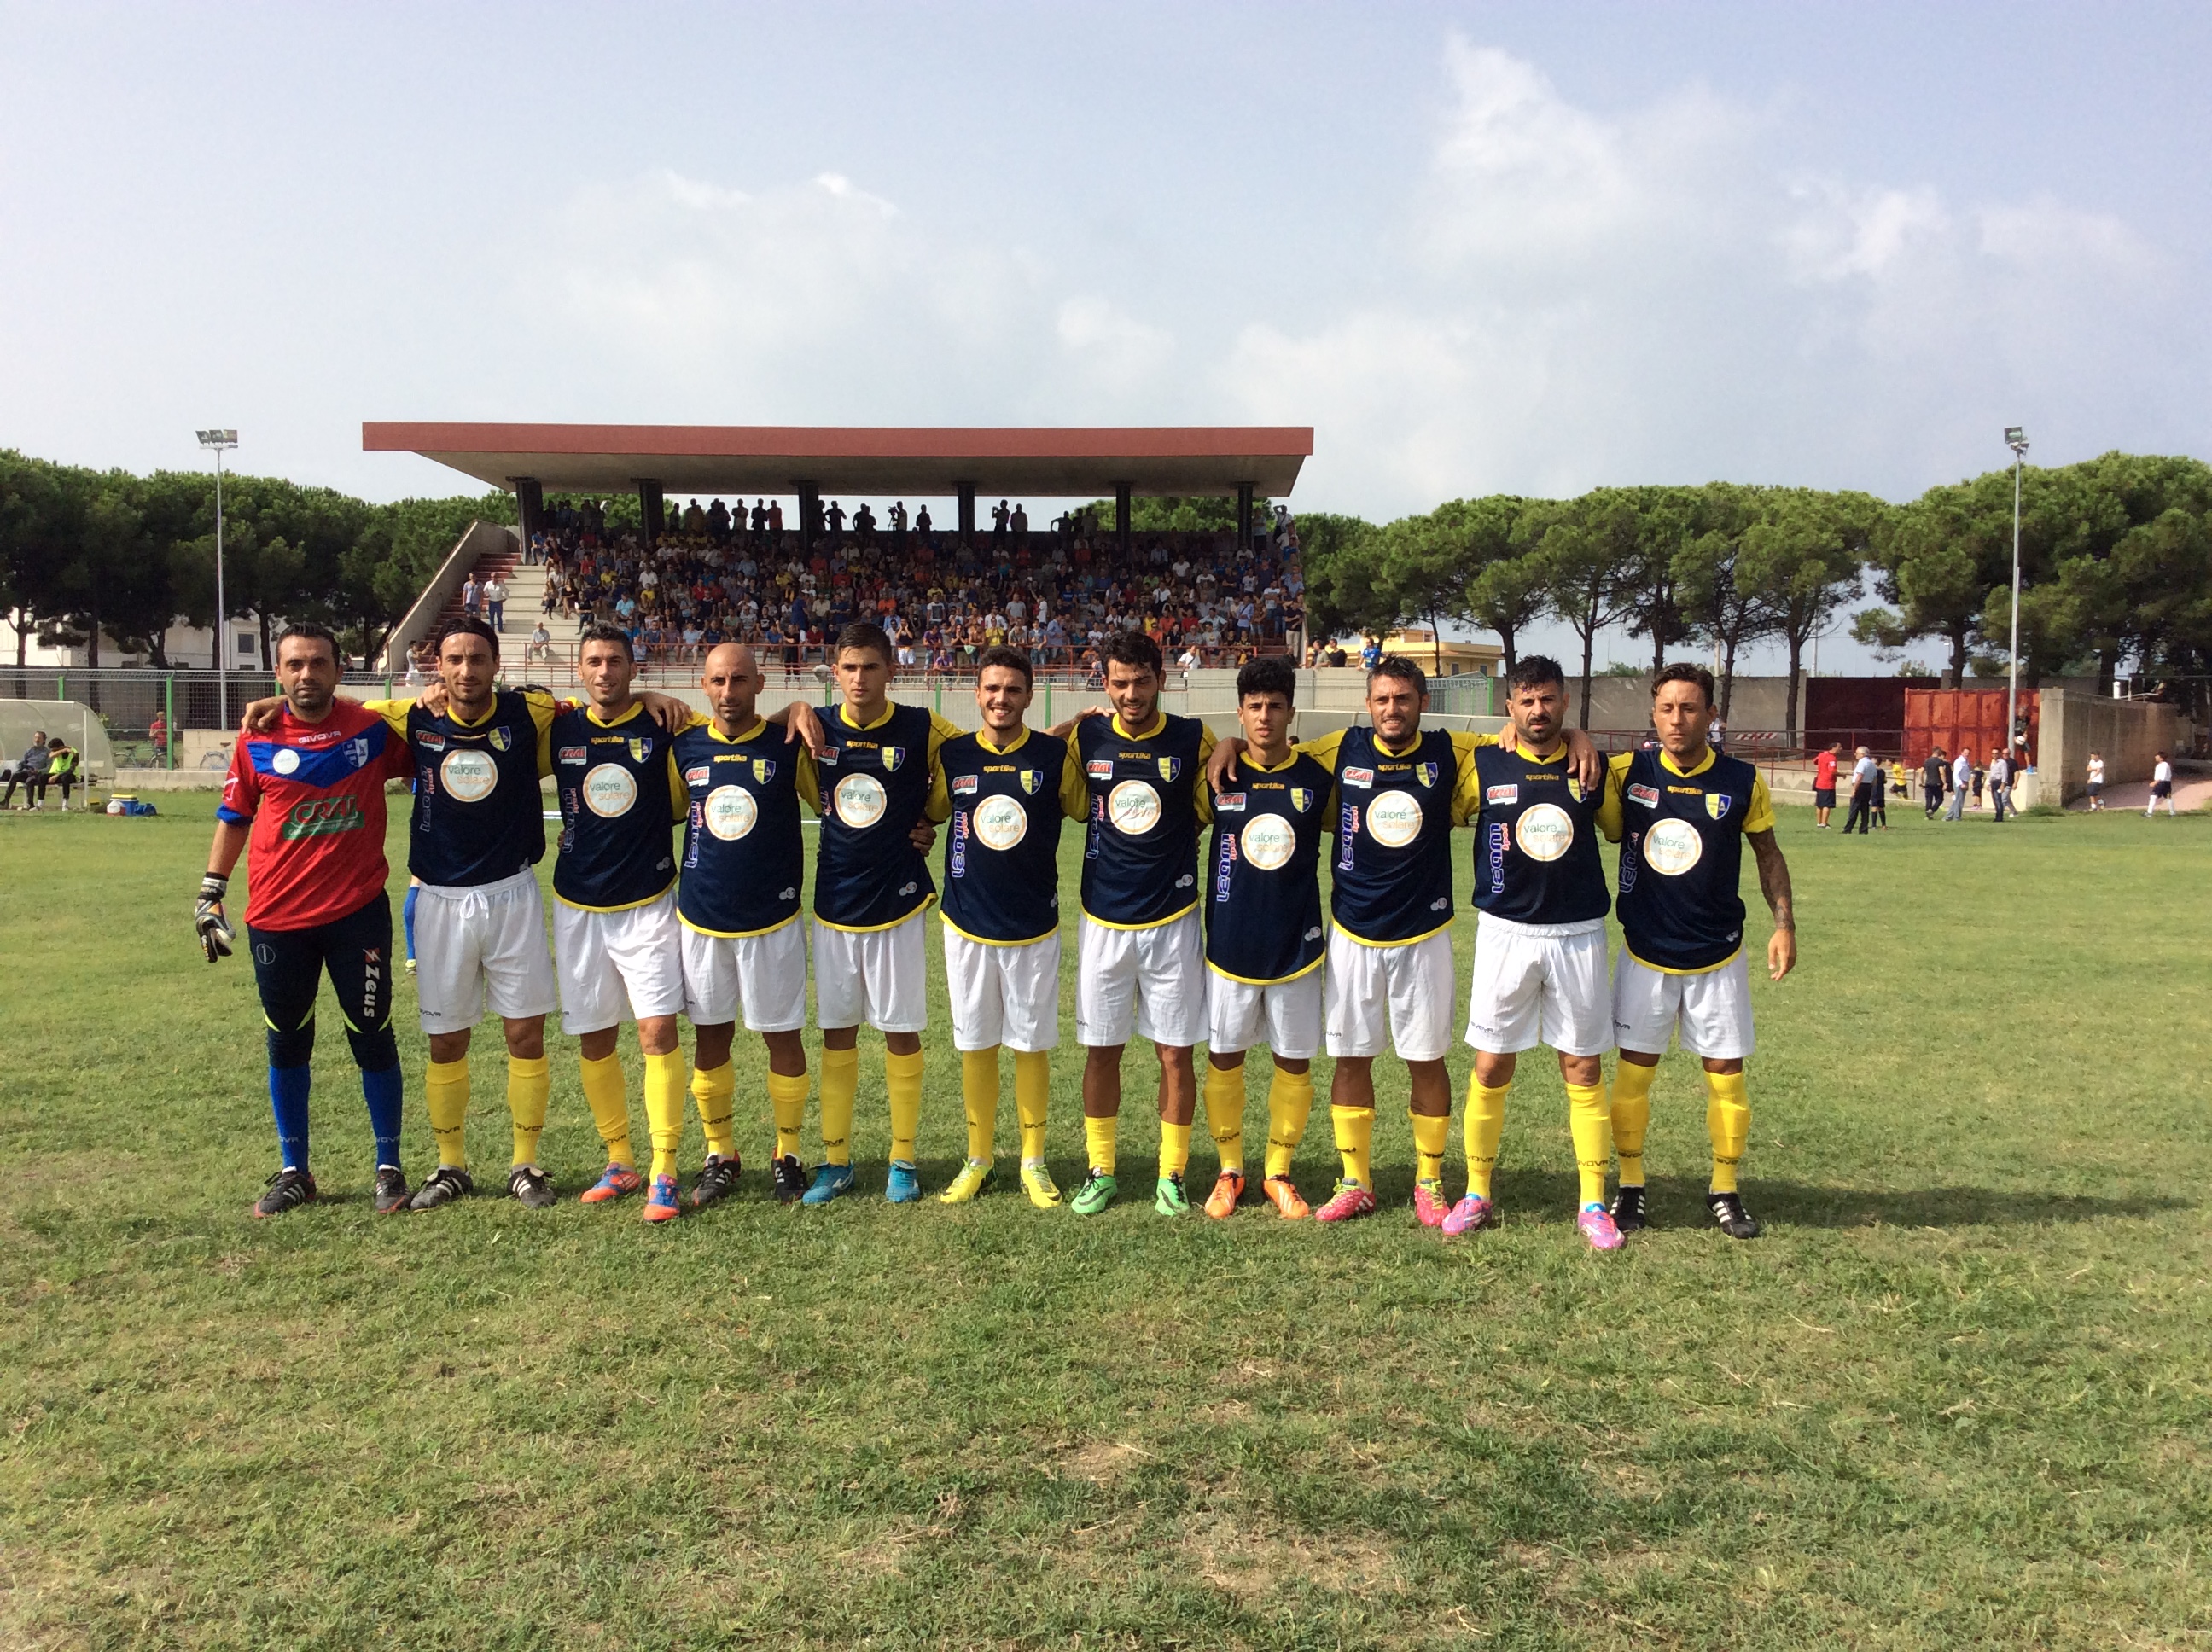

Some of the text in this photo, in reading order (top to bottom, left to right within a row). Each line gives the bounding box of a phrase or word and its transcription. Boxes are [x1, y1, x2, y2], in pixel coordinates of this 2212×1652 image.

[299, 730, 341, 744] GIVOVA
[448, 765, 481, 775] valore
[457, 775, 490, 785] solare
[590, 782, 621, 792] valore
[598, 790, 631, 800] solare
[841, 791, 872, 802] valore
[294, 797, 356, 824] CRAI
[712, 804, 742, 813] valore
[719, 813, 750, 823] solare
[981, 814, 1012, 823] valore
[1375, 810, 1406, 819] valore
[989, 823, 1020, 833] solare
[1382, 820, 1415, 829] solare
[1524, 823, 1557, 833] valore
[1249, 832, 1279, 843] valore
[1533, 834, 1565, 843] solare
[1653, 836, 1685, 850] valore
[364, 964, 380, 1017] Zeus
